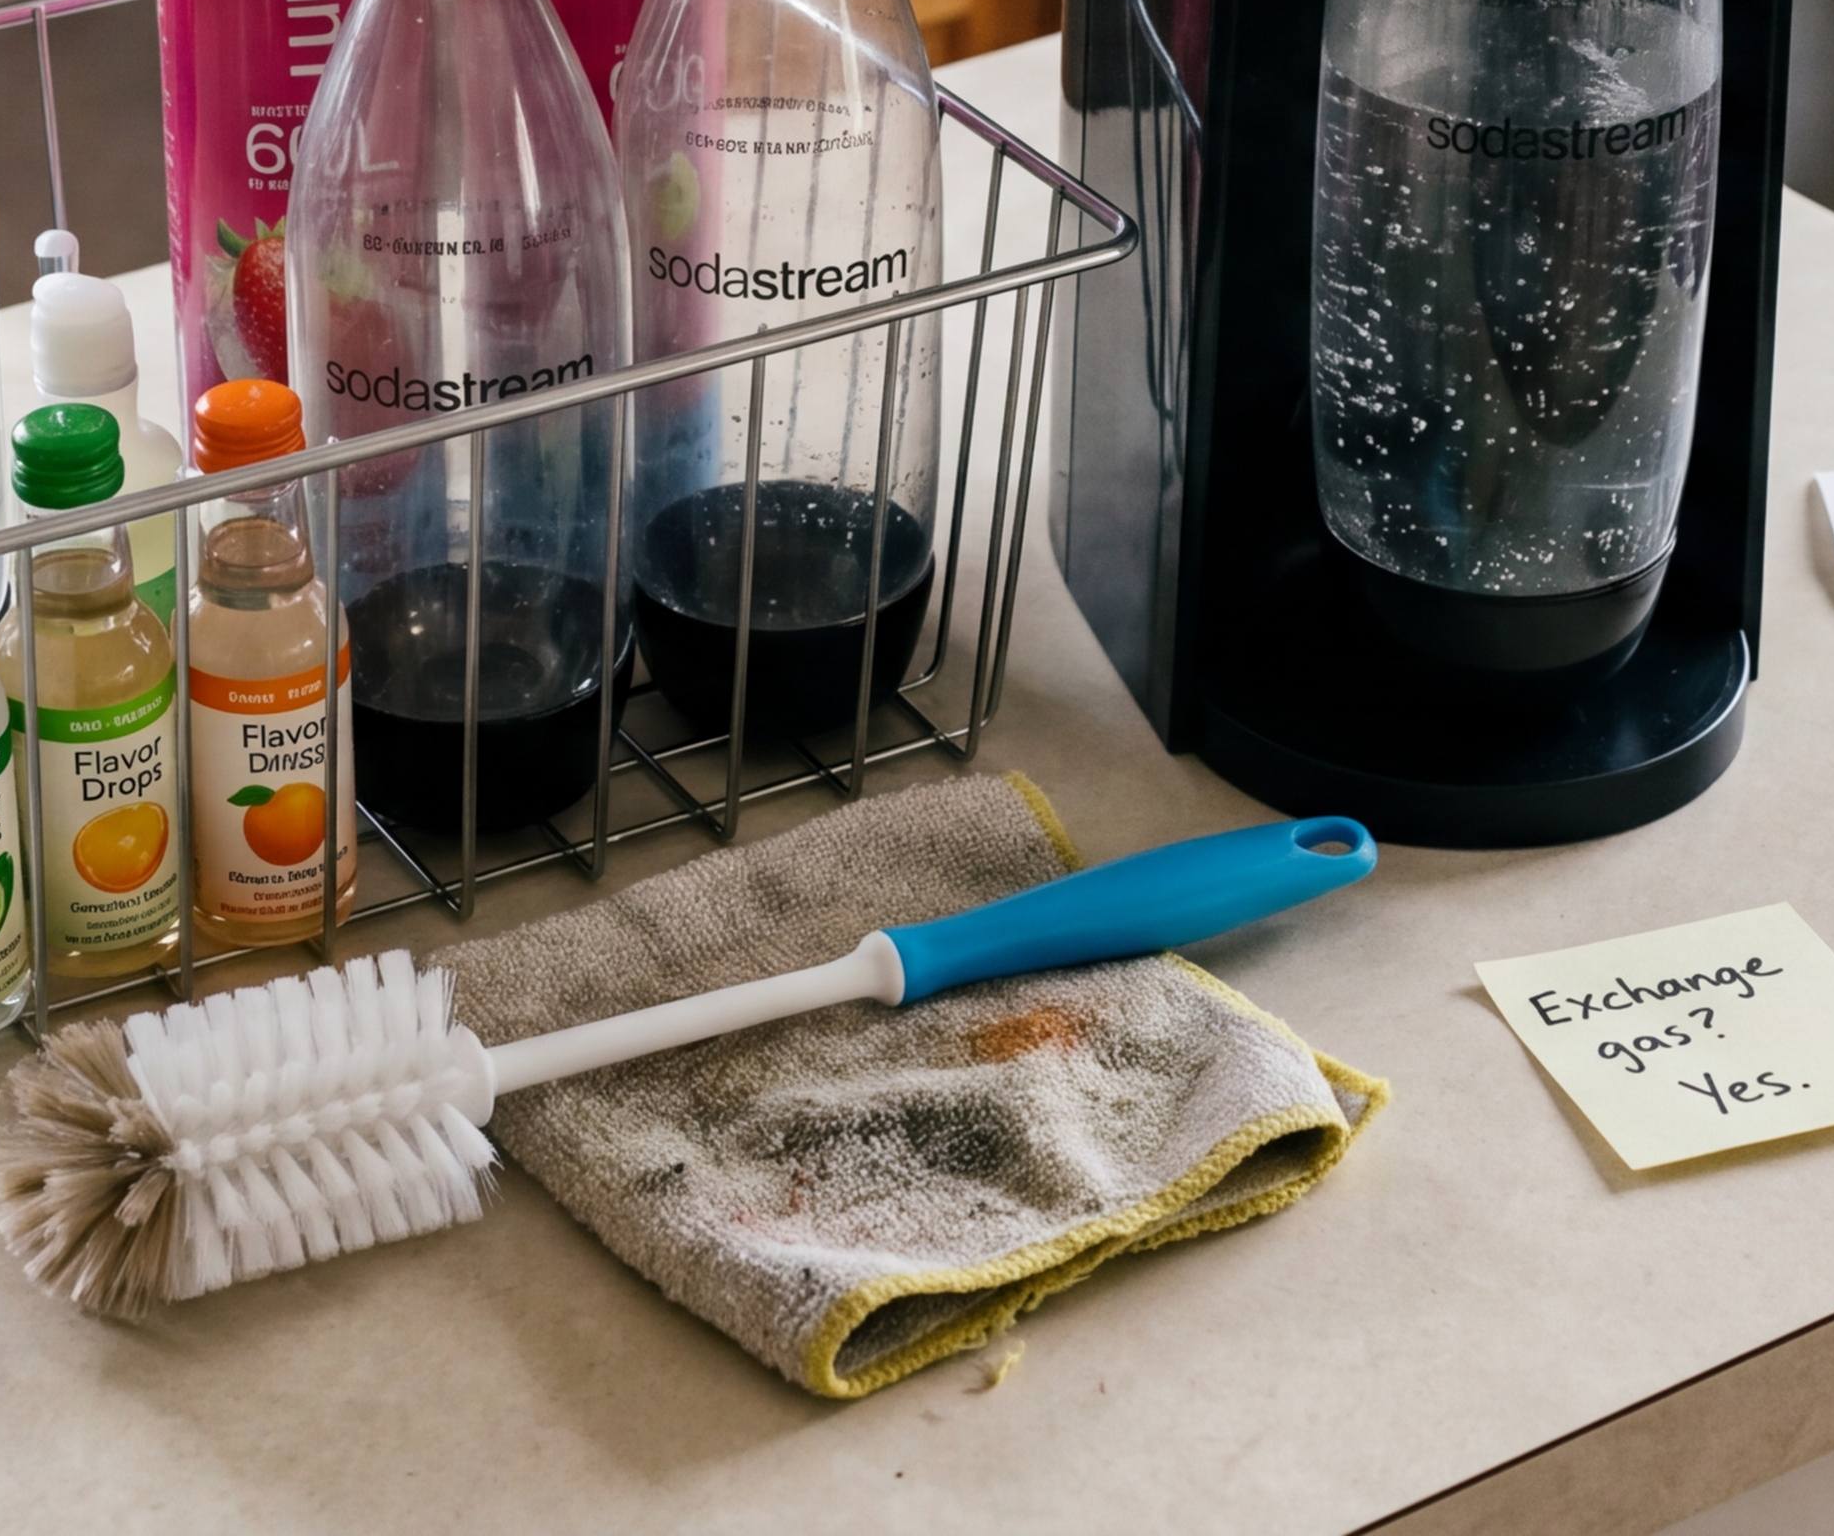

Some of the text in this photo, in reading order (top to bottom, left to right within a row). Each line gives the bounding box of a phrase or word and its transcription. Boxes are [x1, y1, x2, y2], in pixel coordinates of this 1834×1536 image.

[649, 246, 907, 301] sodastream
[242, 716, 326, 749] Flavor
[74, 735, 162, 776] Flavor
[82, 761, 162, 802] Drops
[1529, 955, 1784, 1027] Exchange
[1597, 1006, 1726, 1074] gas?
[1677, 1071, 1812, 1116] Yes.
